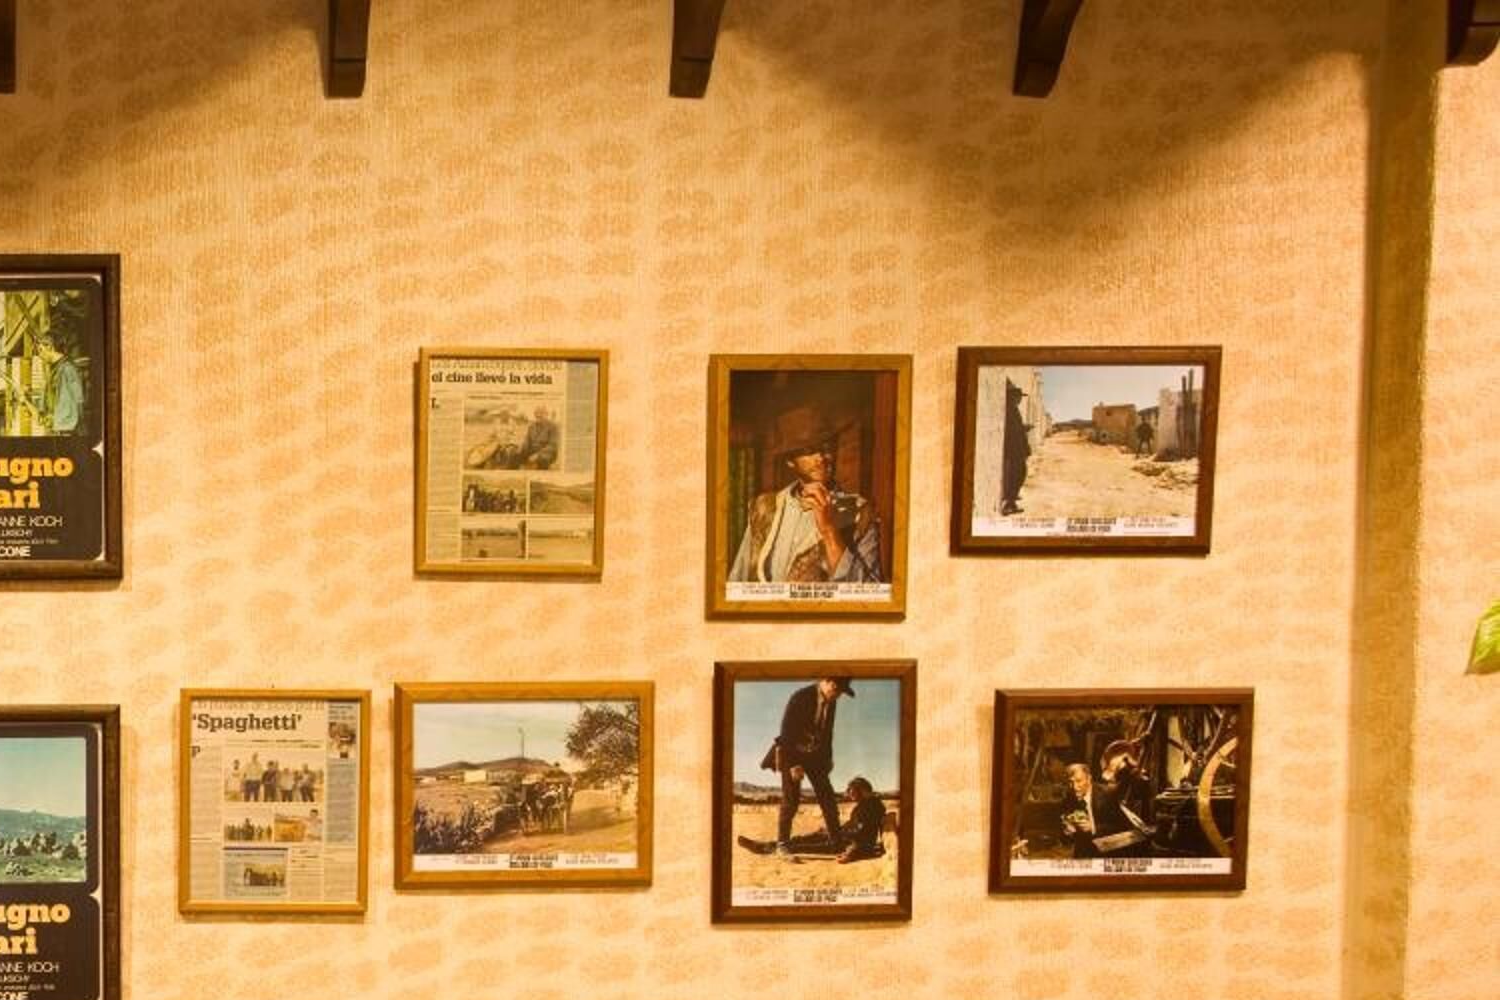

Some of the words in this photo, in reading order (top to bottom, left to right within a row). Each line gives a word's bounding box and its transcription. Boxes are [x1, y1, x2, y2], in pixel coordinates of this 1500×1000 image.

[445, 372, 472, 383] cine
[509, 373, 521, 384] la
[524, 373, 553, 384] vida
[29, 515, 63, 527] KOCH
[27, 961, 60, 973] KOCH
